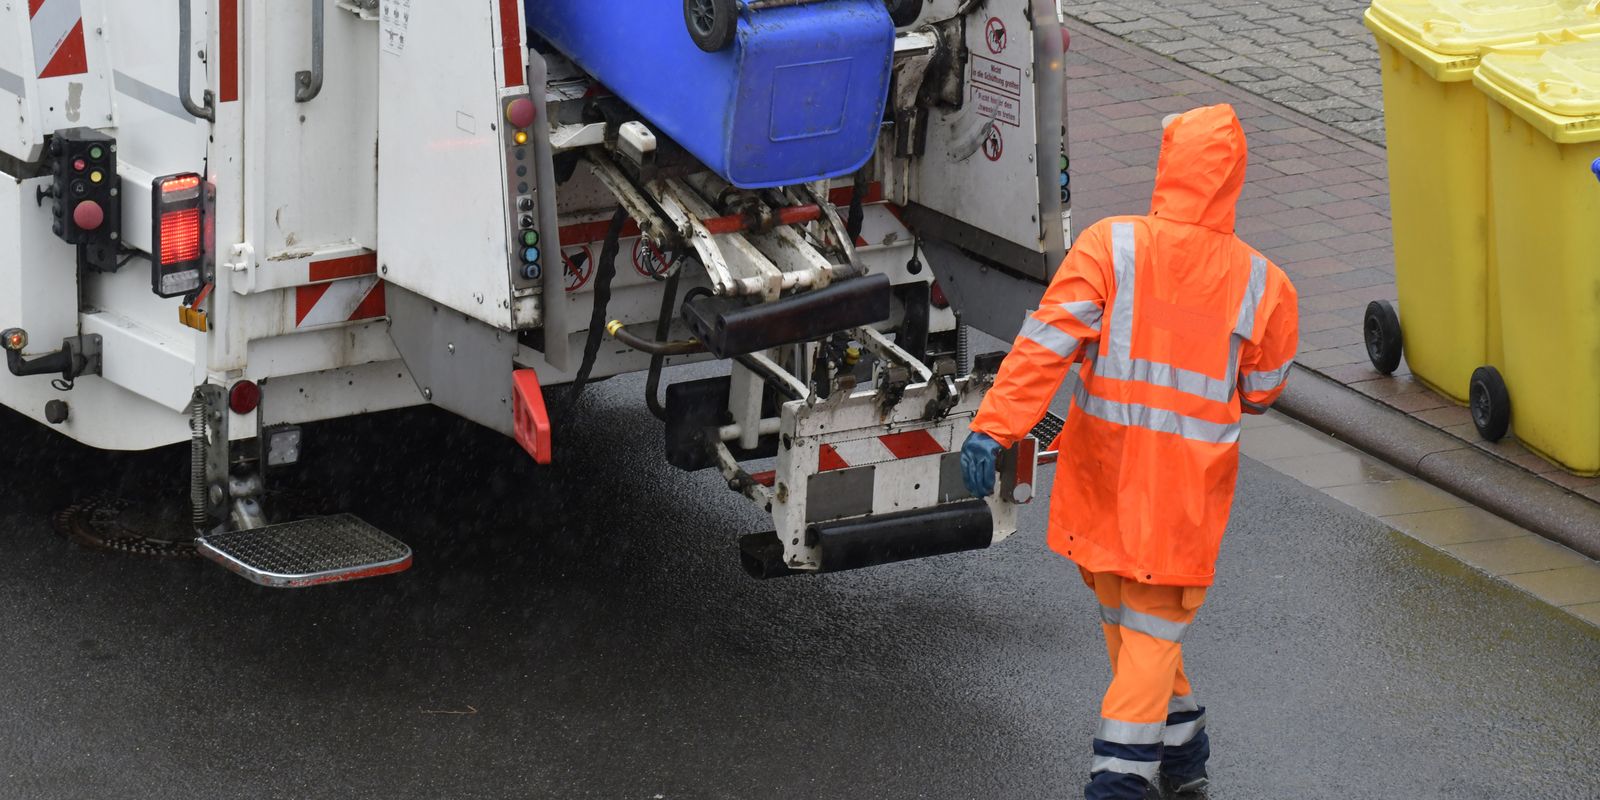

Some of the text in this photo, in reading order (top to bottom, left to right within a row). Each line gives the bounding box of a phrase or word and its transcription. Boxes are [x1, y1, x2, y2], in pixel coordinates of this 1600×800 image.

[991, 64, 1001, 74] Nicht
[1005, 80, 1019, 89] greifen
[1002, 111, 1016, 121] treten
